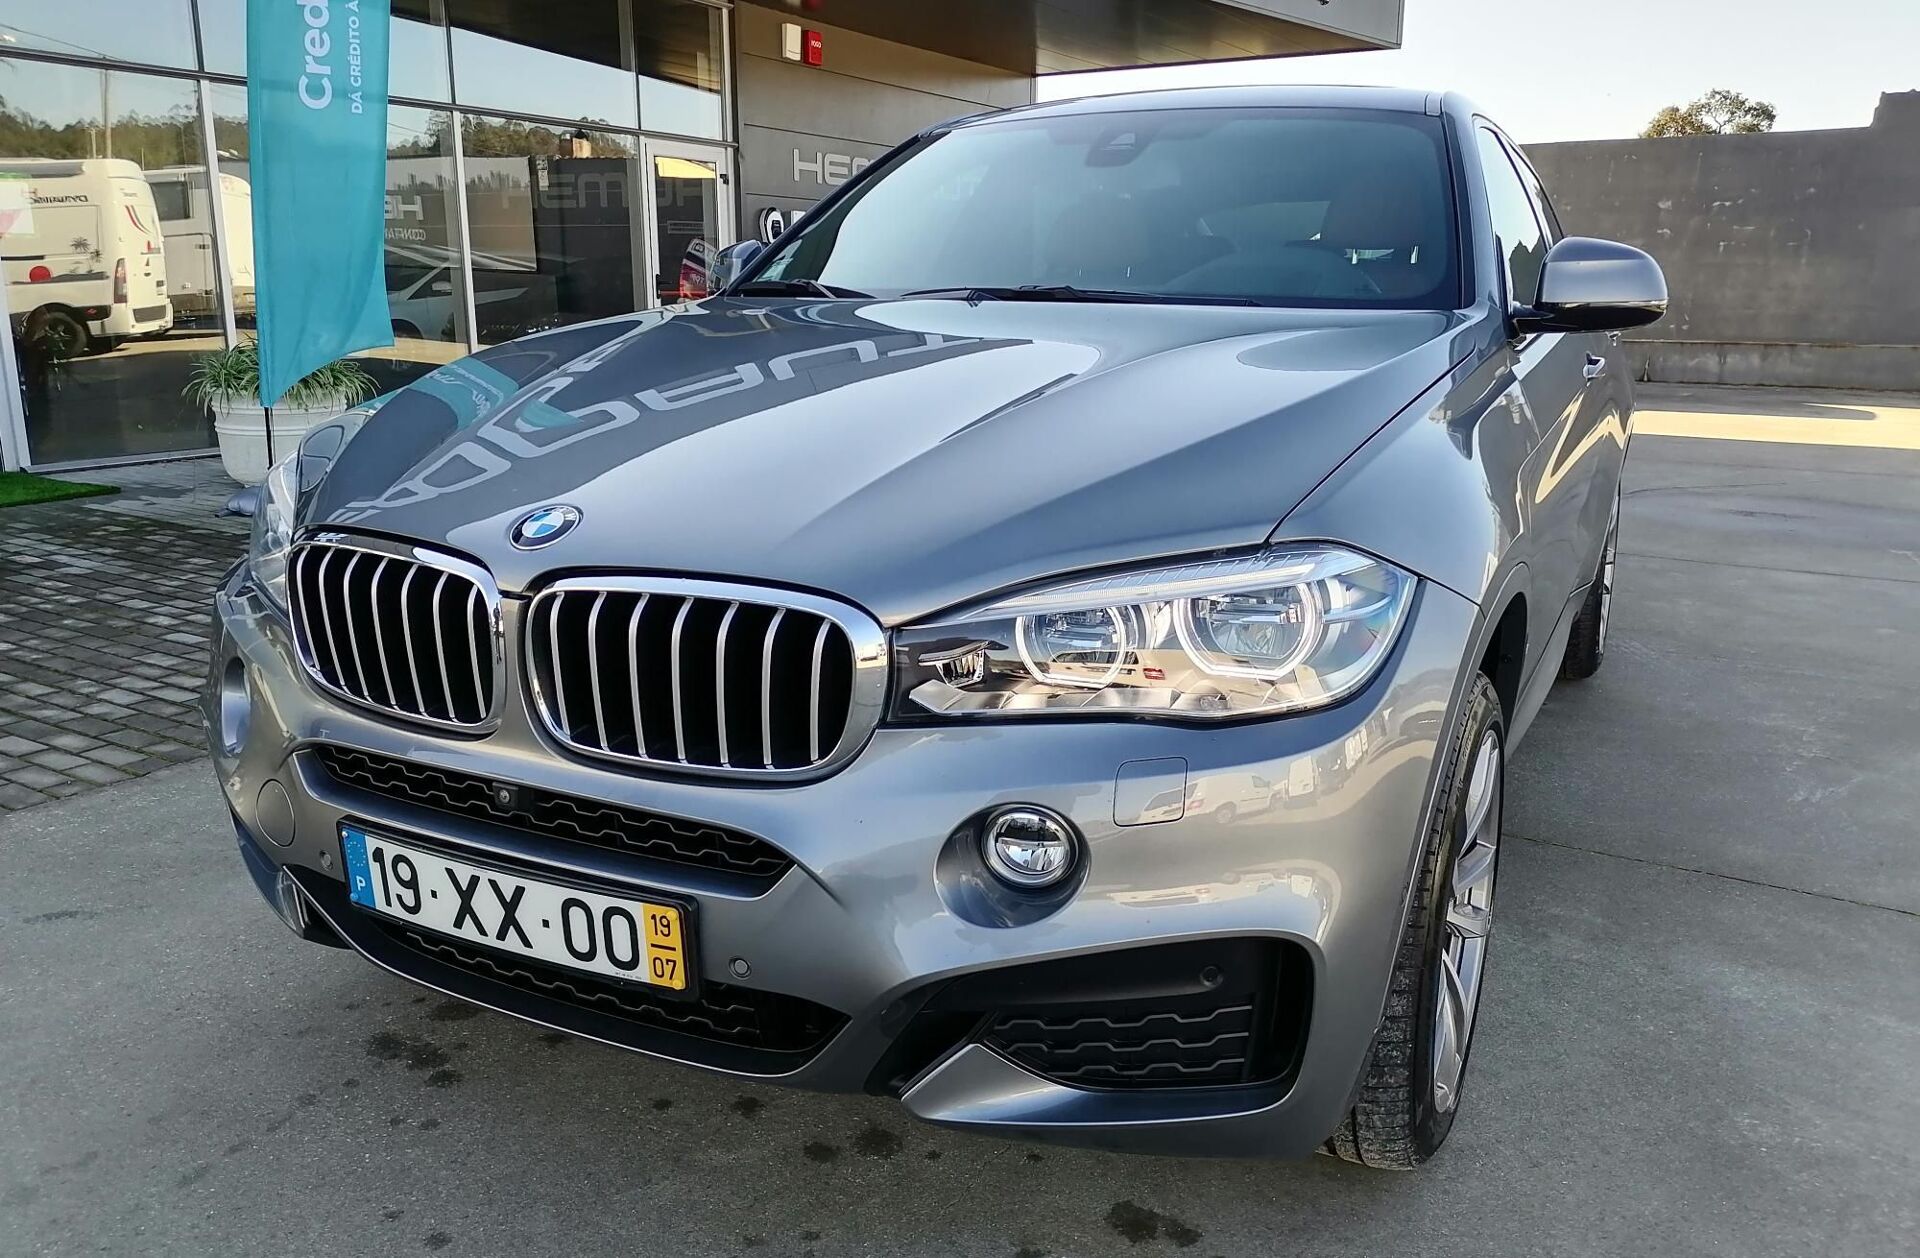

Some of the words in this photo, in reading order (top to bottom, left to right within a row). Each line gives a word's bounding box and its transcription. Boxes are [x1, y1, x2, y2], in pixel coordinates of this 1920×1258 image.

[348, 15, 362, 87] CRÉDITO
[348, 91, 363, 114] DÁ
[356, 875, 367, 892] P
[650, 912, 672, 938] 19
[652, 956, 677, 981] 07
